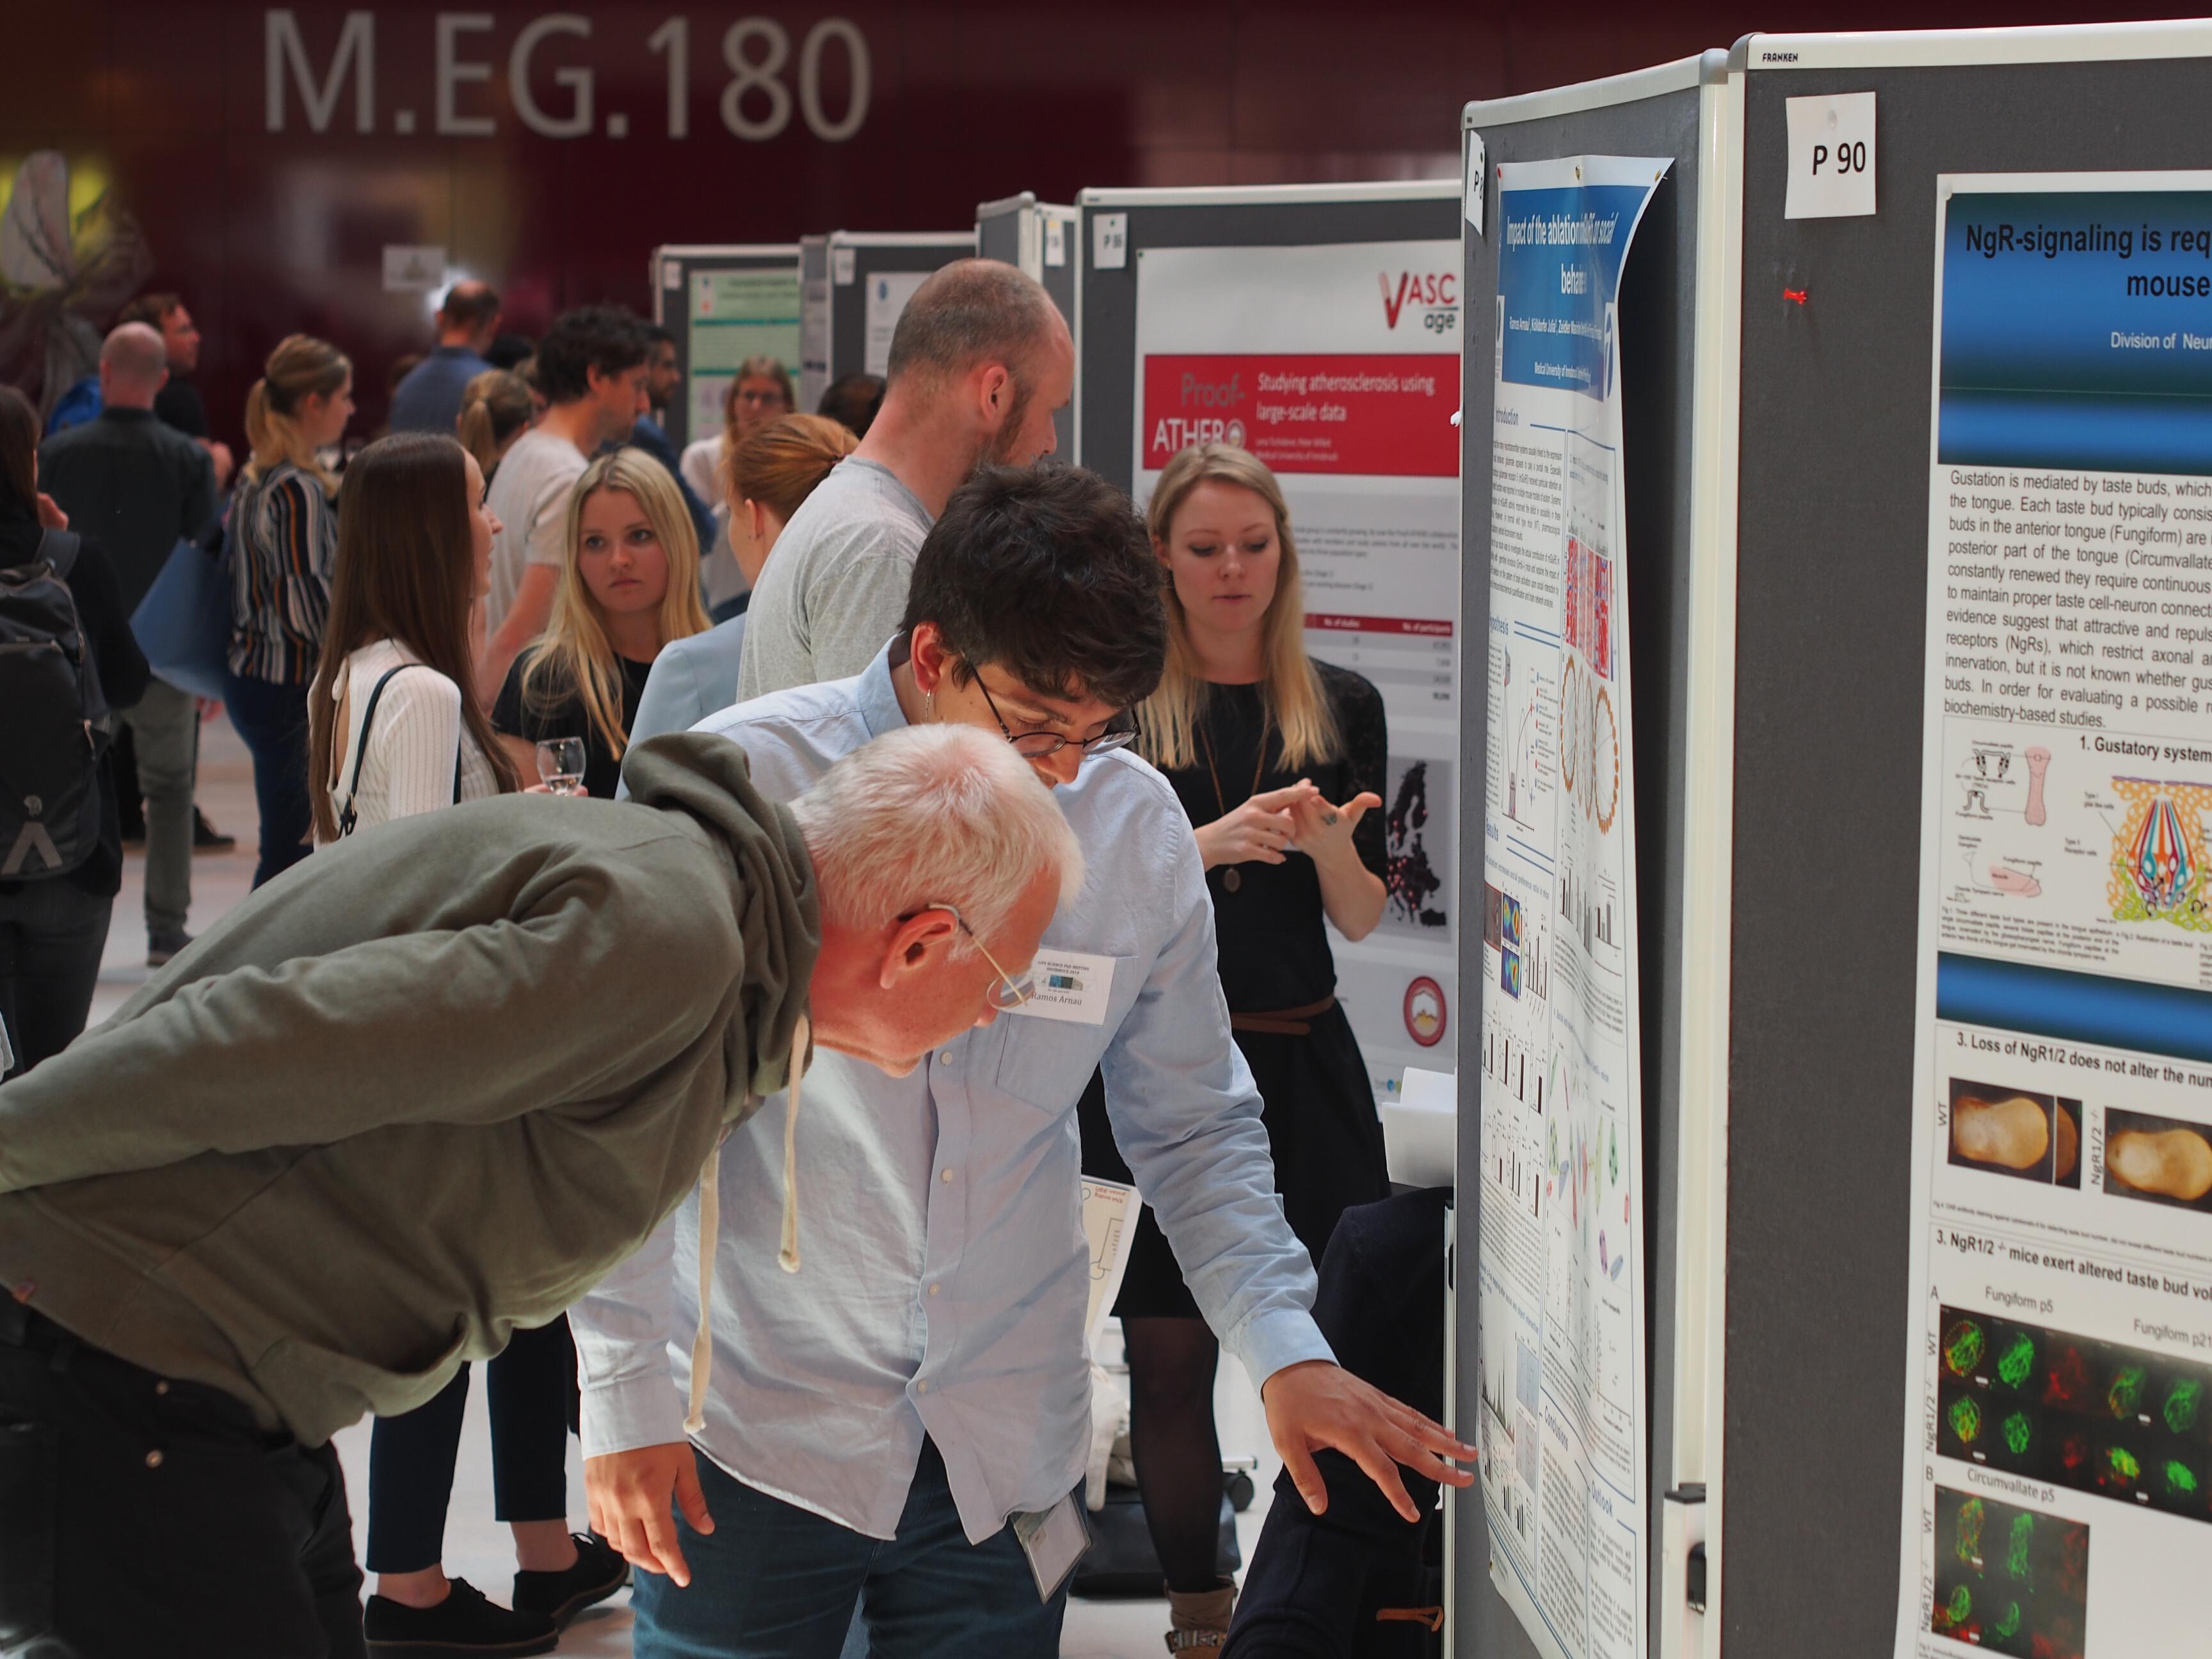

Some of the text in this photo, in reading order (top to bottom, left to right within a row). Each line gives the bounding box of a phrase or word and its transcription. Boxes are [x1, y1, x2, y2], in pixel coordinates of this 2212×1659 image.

[1762, 53, 1799, 63] FRANKEN
[264, 12, 870, 140] M.EG.180
[1812, 142, 1866, 175] P 90
[1507, 216, 1526, 252] Impact
[1528, 215, 1535, 245] of
[1535, 216, 1546, 245] the
[1548, 214, 1578, 245] ablation
[1966, 224, 2211, 259] NgR-signaling is req
[2127, 274, 2210, 297] mouse
[1377, 271, 1456, 330] VASC
[1425, 312, 1455, 333] age
[2111, 332, 2159, 349] Division
[2163, 332, 2176, 349] of
[1258, 373, 1434, 396] Studying atherosclerosis using
[1257, 402, 1347, 422] large-scale data
[1951, 470, 2211, 497] Gustation is mediated by taste buds, which
[1950, 494, 1967, 508] the
[1972, 496, 2014, 513] tongue.
[2021, 497, 2051, 512] Each
[2056, 500, 2085, 514] taste
[2090, 501, 2113, 515] bud
[2119, 503, 2168, 522] typically
[1950, 517, 2206, 547] buds in the anterior tongue (Fungiform) are
[1948, 541, 1998, 558] posterior
[2004, 544, 2026, 559] part
[2033, 545, 2045, 559] of
[2051, 545, 2069, 560] the
[2077, 548, 2118, 566] tongue
[1948, 564, 2210, 594] constantly renewed they require continuous
[1948, 586, 1957, 599] to
[1961, 586, 2009, 602] maintain
[2013, 592, 2051, 607] proper
[2056, 594, 2085, 609] taste
[2089, 596, 2156, 613] cell-neuron
[1947, 609, 1996, 625] evidence
[2003, 613, 2049, 631] suggest
[2055, 616, 2078, 631] that
[2084, 620, 2139, 636] attractive
[2145, 624, 2168, 638] and
[1946, 632, 2193, 664] receptors (NgRs), which restrict axonal
[1946, 653, 2010, 673] innervation,
[2016, 661, 2033, 675] but
[2039, 662, 2046, 675] it
[2051, 663, 2061, 677] is
[2067, 664, 2085, 678] not
[2090, 666, 2130, 682] known
[2136, 671, 2186, 688] whether
[1945, 675, 2197, 712] buds. In order for evaluating a possible
[1944, 698, 2105, 727] biochemistry-based studies.
[2080, 736, 2212, 763] 1. Gustatory system
[1032, 993, 1082, 1006] Ramos Arnau
[1957, 1032, 1967, 1047] 3.
[1971, 1035, 2000, 1052] Loss
[2005, 1041, 2017, 1055] of
[2021, 1043, 2065, 1063] NgR1/2
[2070, 1050, 2100, 1070] does
[2105, 1057, 2126, 1073] not
[2129, 1061, 2159, 1080] alter
[2163, 1066, 2184, 1084] the
[1938, 1102, 1947, 1126] WT
[1937, 1230, 1946, 1246] 3.
[1951, 1233, 1994, 1255] NgR1/2
[2009, 1247, 2039, 1265] mice
[2043, 1256, 2074, 1272] exert
[2079, 1262, 2122, 1282] altered
[2127, 1271, 2159, 1290] taste
[2163, 1277, 2188, 1296] bud
[1930, 1286, 1938, 1300] A
[1986, 1286, 2037, 1310] Fungiform
[1928, 1332, 1937, 1356] WT
[2134, 1318, 2189, 1343] Fungiform
[1544, 1406, 1568, 1452] Conclusions
[1925, 1466, 1934, 1480] B
[1968, 1468, 2039, 1499] Circumvallate
[1592, 1480, 1613, 1517] Outlook
[1924, 1509, 1933, 1534] WT
